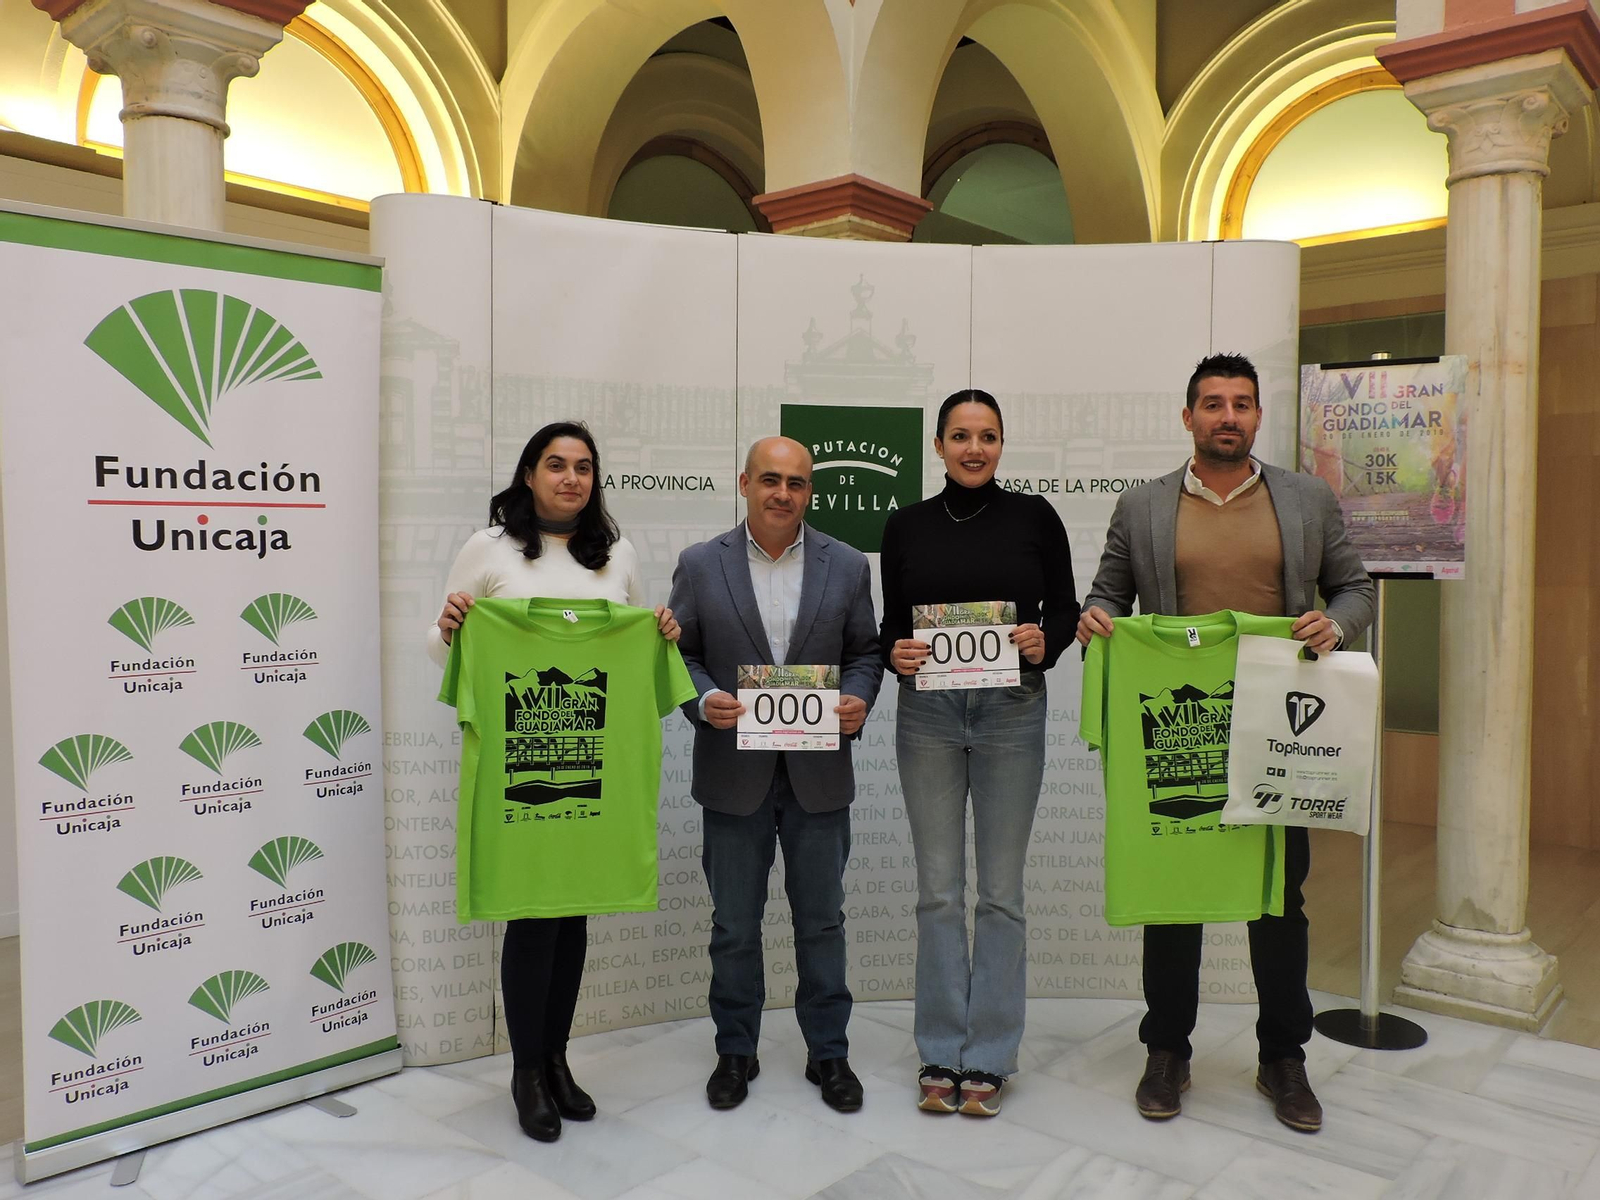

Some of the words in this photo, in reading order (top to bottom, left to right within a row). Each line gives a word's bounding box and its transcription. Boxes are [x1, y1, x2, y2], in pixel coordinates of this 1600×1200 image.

[1341, 371, 1387, 400] VII
[1393, 383, 1444, 398] GRAN
[1323, 402, 1387, 418] FONDO
[1391, 400, 1412, 410] DEL
[1323, 410, 1442, 432] GUADIAMAR
[1342, 432, 1353, 440] DE
[1361, 431, 1391, 439] ENERO
[1399, 430, 1411, 438] DE
[809, 440, 903, 467] PUTACION
[1365, 453, 1398, 469] 30K
[94, 454, 322, 493] Fundación
[601, 474, 616, 490] A
[621, 475, 715, 491] PROVINCIA
[839, 475, 855, 485] DE
[1365, 470, 1398, 485] 15K
[1038, 479, 1059, 493] DE
[1065, 479, 1085, 493] LA
[131, 514, 292, 560] Unicaja
[931, 630, 1001, 664] 000
[111, 657, 195, 674] Fundación
[242, 649, 318, 665] Fundación
[123, 677, 183, 694] Unicaja
[253, 668, 307, 684] Unicaja
[527, 687, 561, 709] VII
[562, 699, 597, 709] GRAN
[516, 710, 560, 721] FONDO
[754, 693, 823, 725] 000
[1163, 703, 1198, 727] VII
[516, 718, 596, 732] GUADIAMAR
[1154, 726, 1199, 739] FONDO
[868, 734, 887, 747] LA
[1267, 738, 1342, 757] TopRunner
[305, 761, 372, 781] Fundación
[181, 776, 263, 796] Fundación
[316, 779, 364, 799] Unicaja
[41, 794, 134, 815] Fundación
[194, 797, 253, 816] Unicaja
[55, 814, 122, 836] Unicaja
[1327, 812, 1343, 820] WEAR
[1033, 830, 1065, 844] SAN
[880, 856, 896, 869] EL
[866, 881, 886, 894] DE
[890, 880, 918, 894] GU
[250, 888, 325, 912] Fundación
[261, 909, 315, 930] Unicaja
[848, 905, 895, 920] GABA,
[119, 911, 204, 937] Fundación
[619, 925, 649, 942] DEL
[654, 920, 686, 938] RÍO,
[132, 933, 192, 956] Unicaja
[1058, 928, 1078, 942] DE
[1084, 928, 1102, 942] LA
[390, 956, 446, 973] CORIA
[453, 952, 485, 970] DEL
[859, 952, 915, 968] GELVES
[1069, 952, 1098, 966] DEL
[645, 973, 675, 991] DEL
[1033, 975, 1128, 991] VALENCINA
[310, 988, 377, 1017] Fundación
[621, 1001, 655, 1021] SAN
[322, 1010, 369, 1033] Unicaja
[433, 1011, 457, 1028] DE
[463, 1005, 505, 1024] GUZ
[190, 1021, 271, 1050] Fundación
[203, 1043, 259, 1068] Unicaja
[439, 1037, 463, 1055] DE
[51, 1054, 143, 1086] Fundación
[65, 1078, 130, 1105] Unicaja
